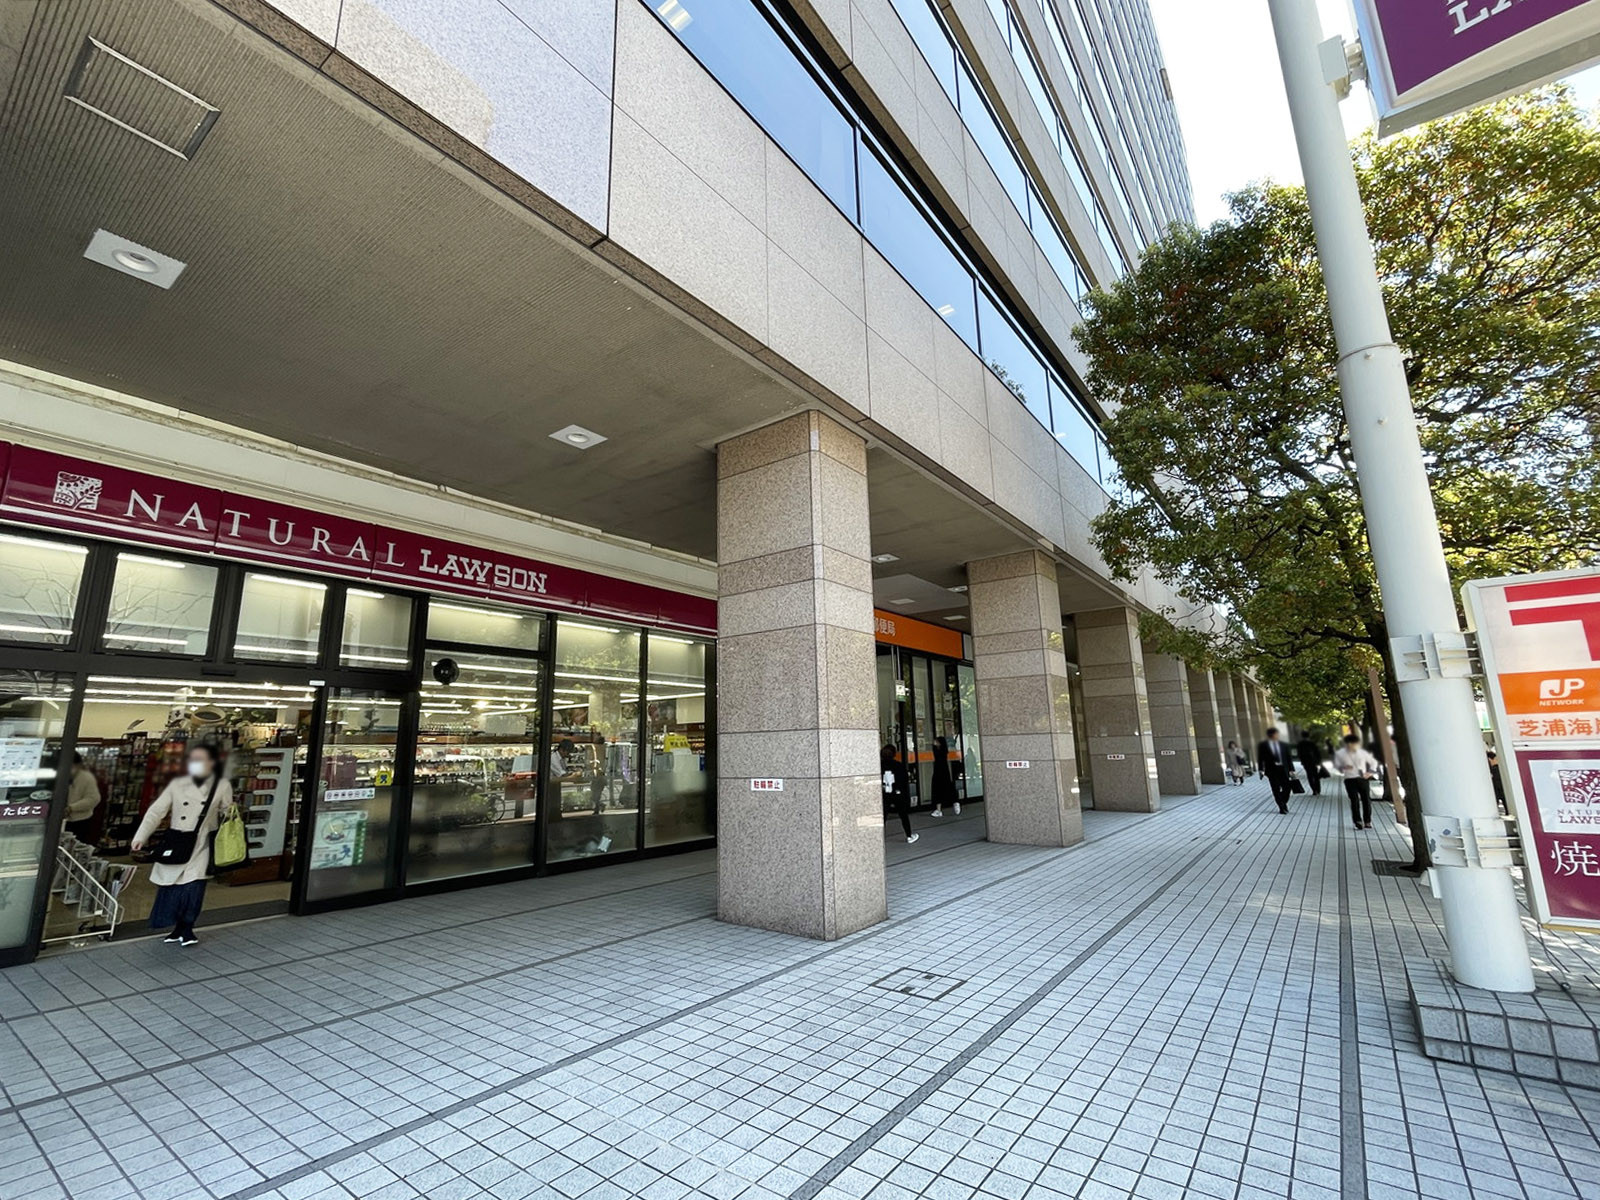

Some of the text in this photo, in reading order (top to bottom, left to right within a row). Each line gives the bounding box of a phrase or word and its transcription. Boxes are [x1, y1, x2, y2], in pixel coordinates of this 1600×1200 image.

[123, 488, 548, 594] NATURAL LAWSON
[1539, 699, 1584, 707] NETWORK
[3, 806, 42, 817] たばこ
